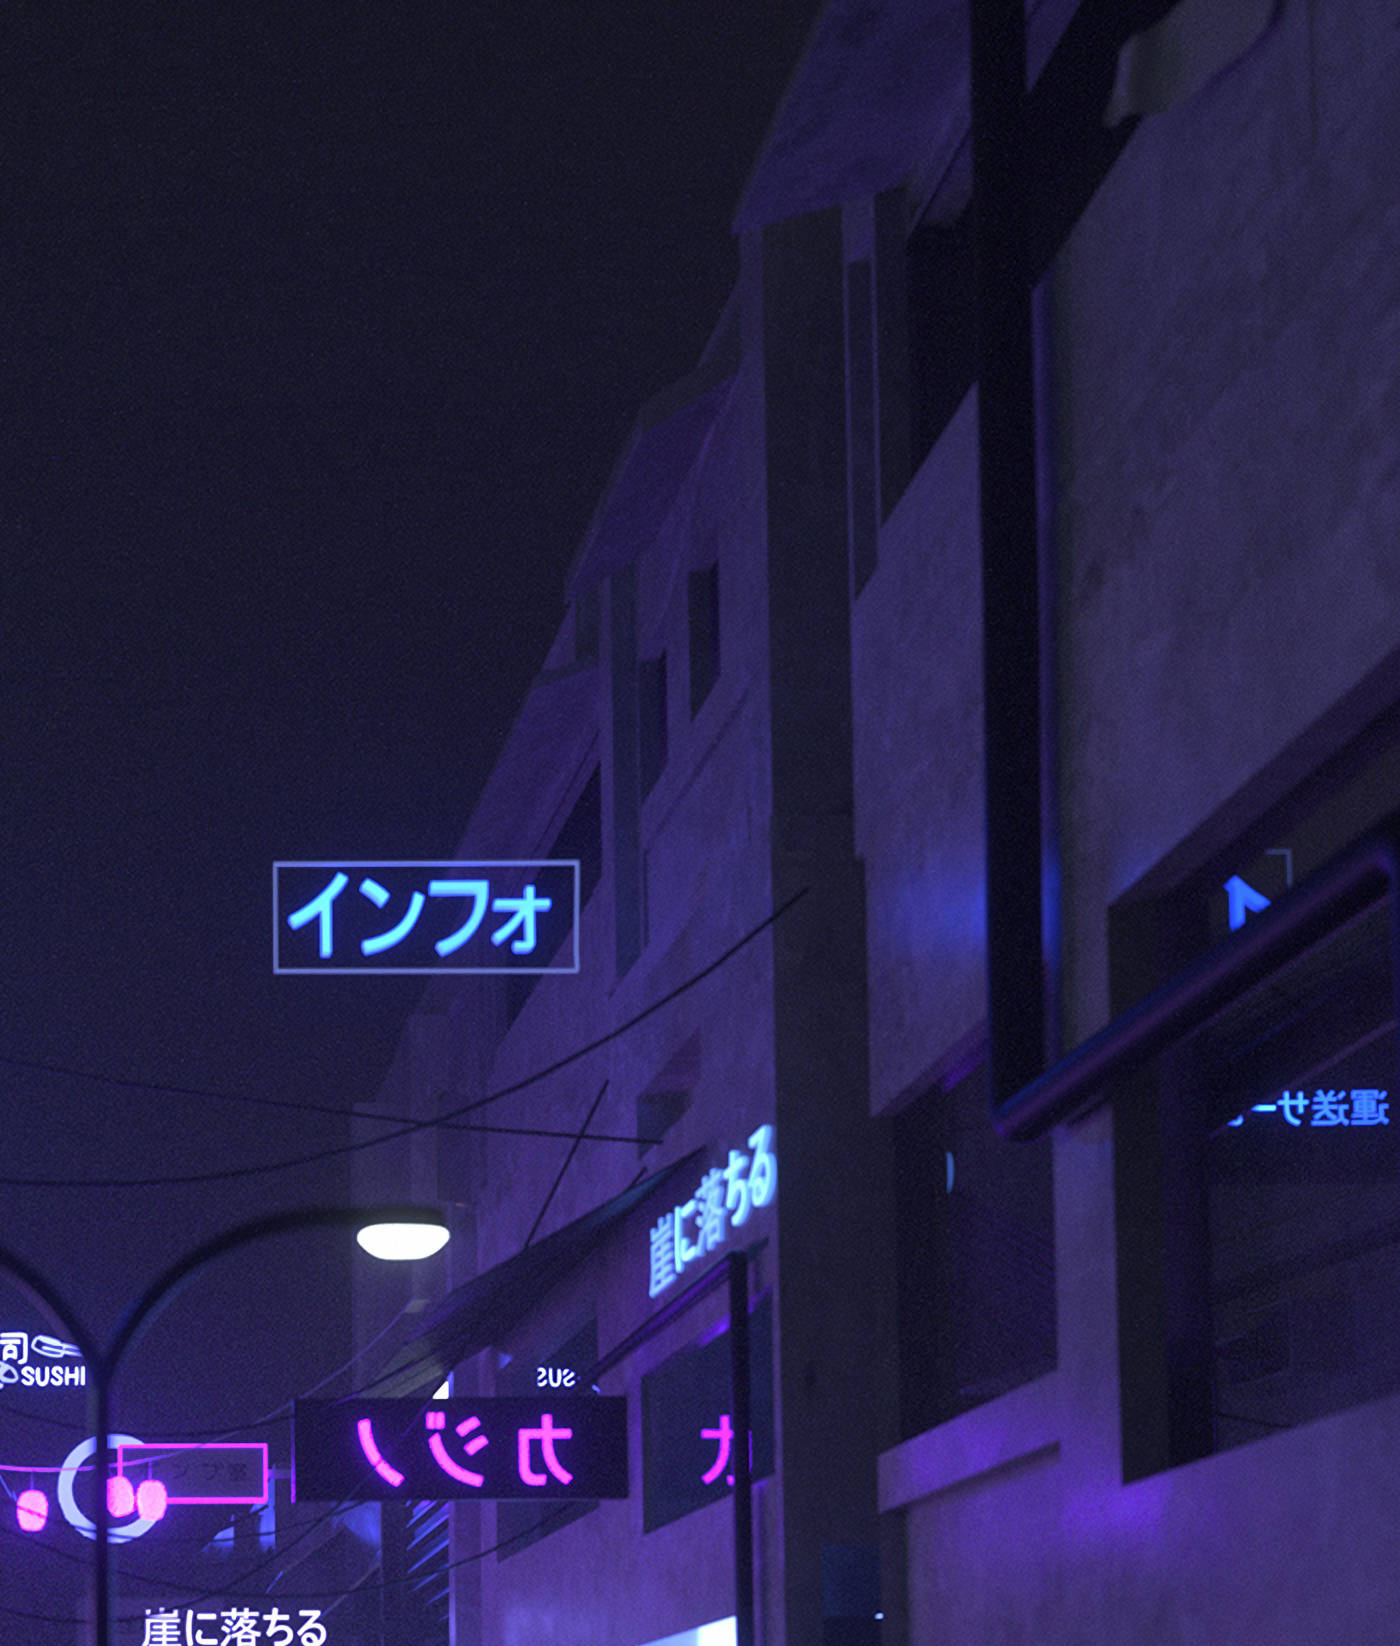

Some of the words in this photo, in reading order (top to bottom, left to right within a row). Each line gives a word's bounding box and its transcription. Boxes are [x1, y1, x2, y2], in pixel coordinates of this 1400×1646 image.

[287, 871, 552, 958] インフォ
[649, 1124, 778, 1298] 崖に落ちる
[20, 1365, 86, 1387] SUSHI
